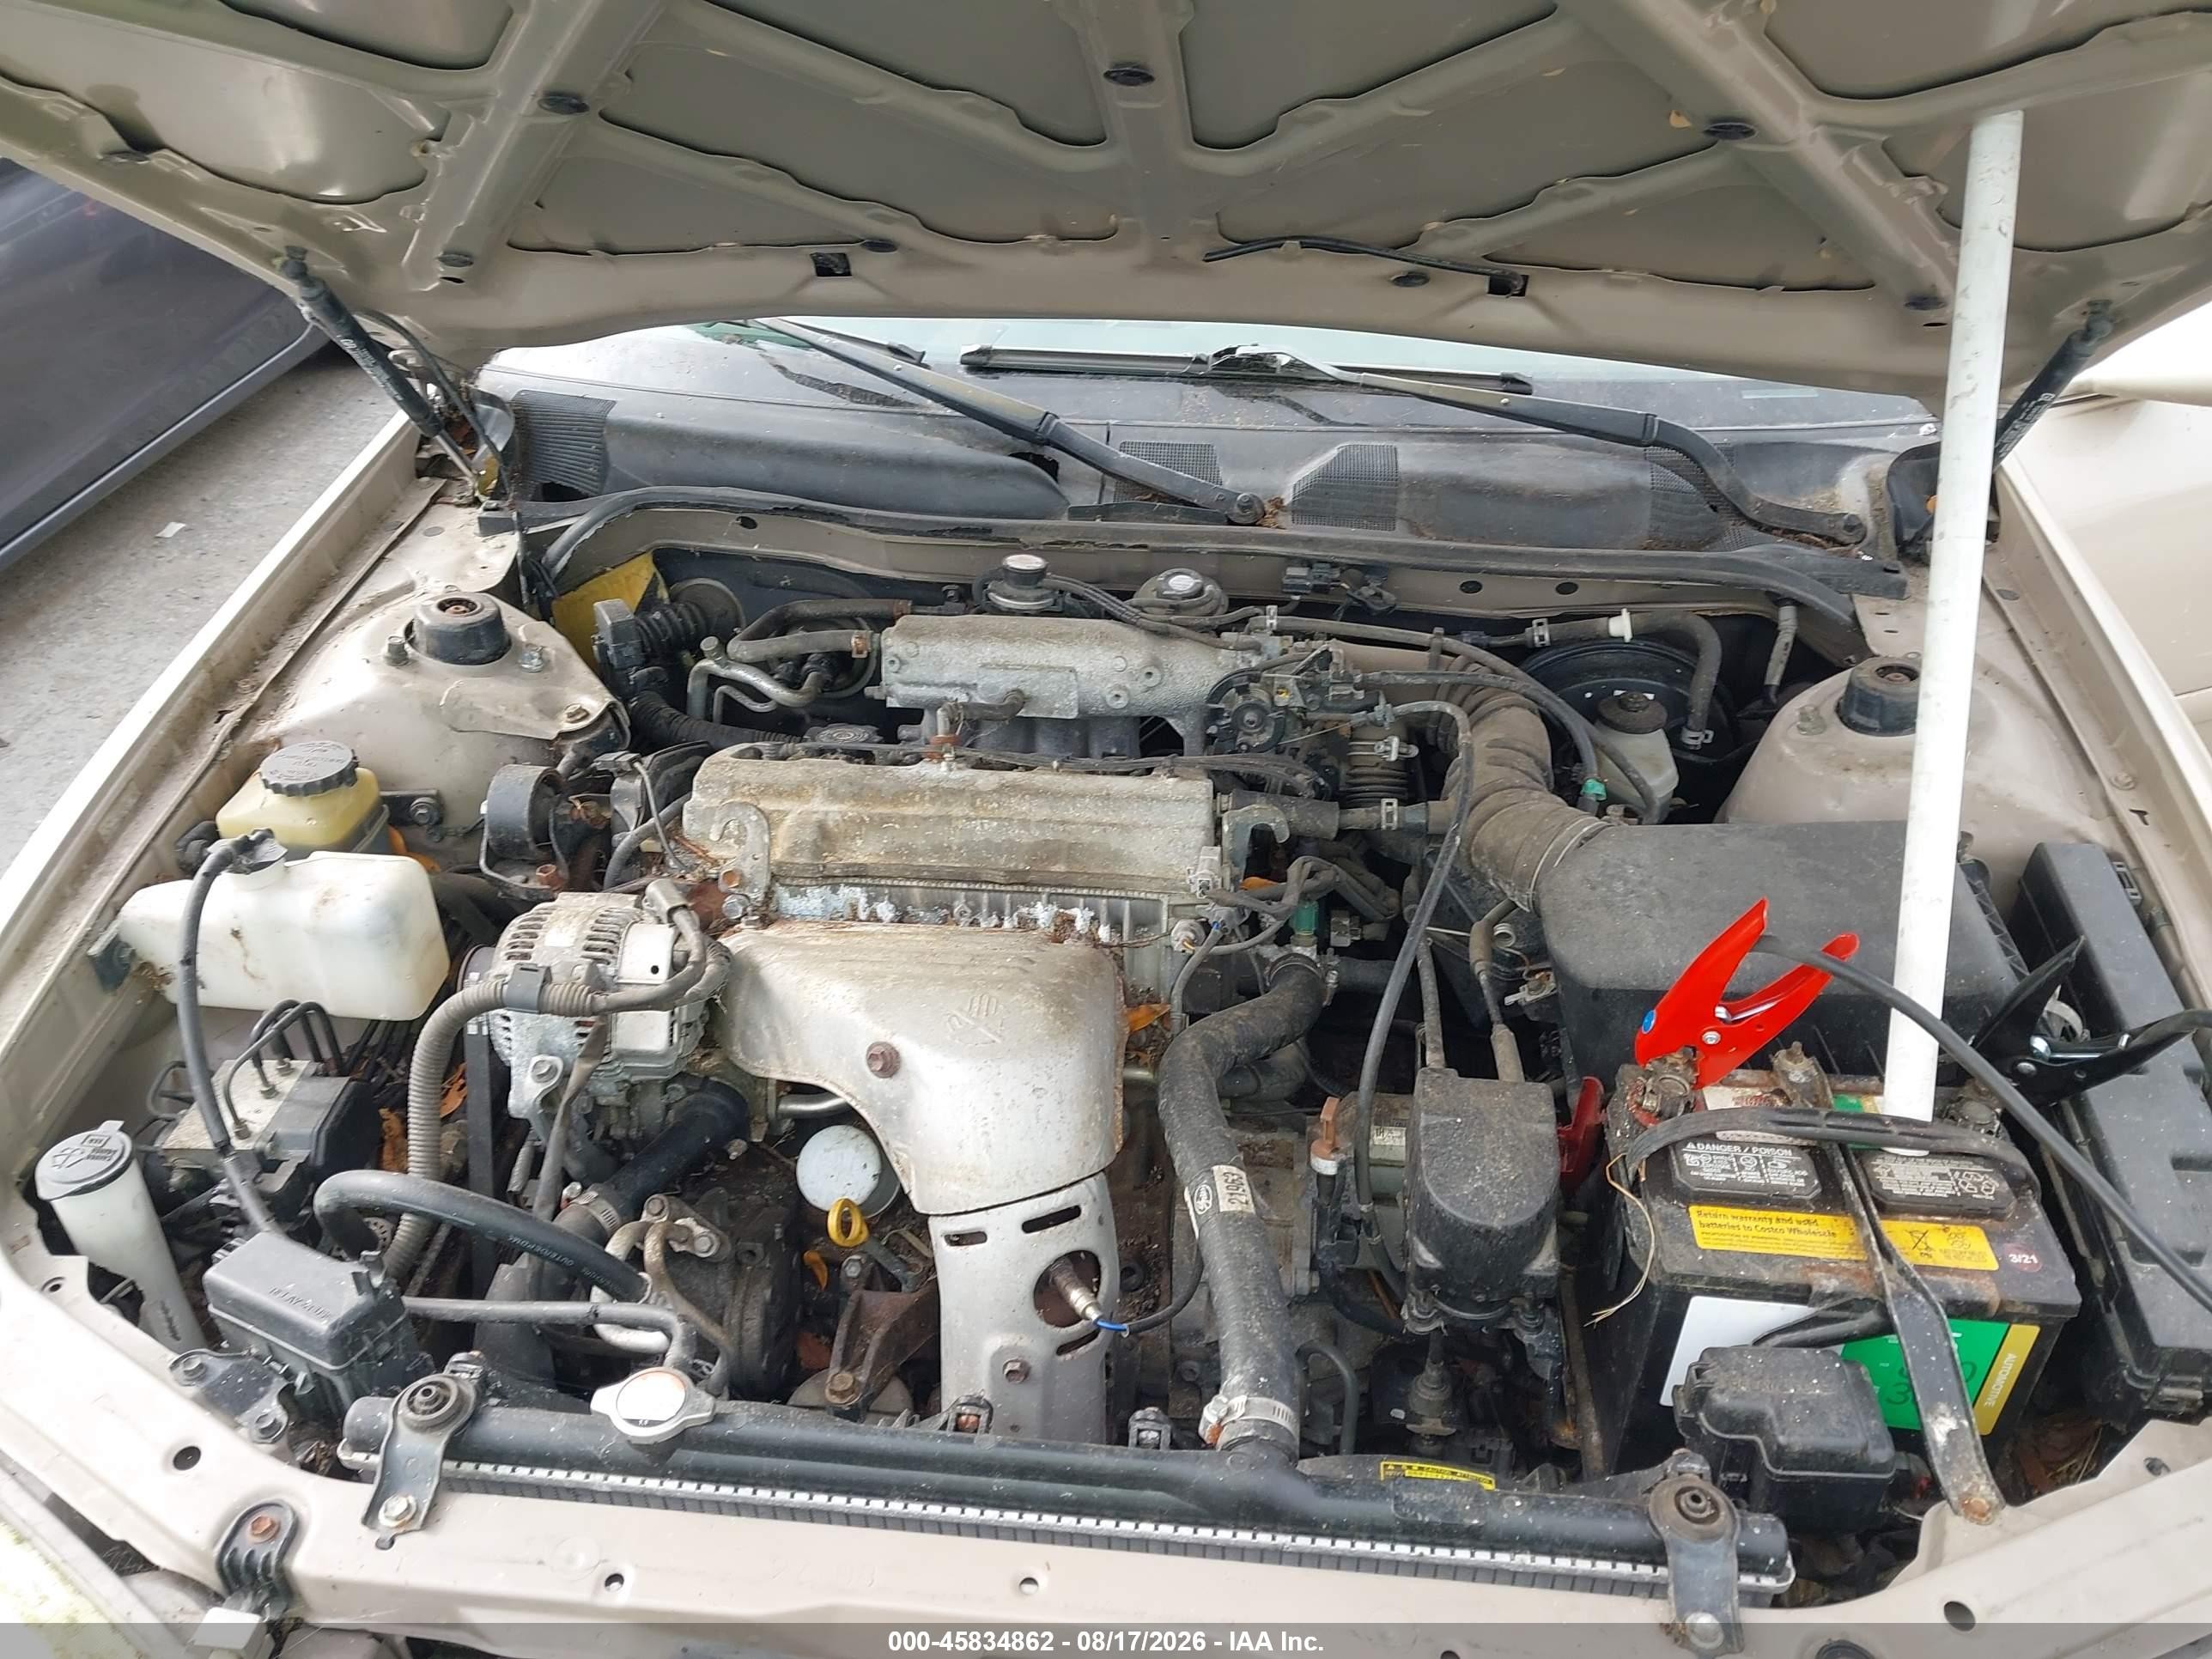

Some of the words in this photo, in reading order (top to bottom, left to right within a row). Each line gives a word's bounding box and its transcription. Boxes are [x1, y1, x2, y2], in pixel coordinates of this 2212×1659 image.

[1696, 1142, 1741, 1153] DANGER
[1752, 1146, 1793, 1156] POISON
[1696, 1210, 1728, 1220] Return
[1731, 1214, 1772, 1225] warranty
[1775, 1217, 1793, 1225] and
[1698, 1222, 1740, 1231] batteries
[1754, 1225, 1784, 1234] Costco
[1786, 1227, 1837, 1238] Wholesale
[2008, 1254, 2039, 1264] 3/21
[1984, 1352, 2018, 1408] AUTOMOTIVE
